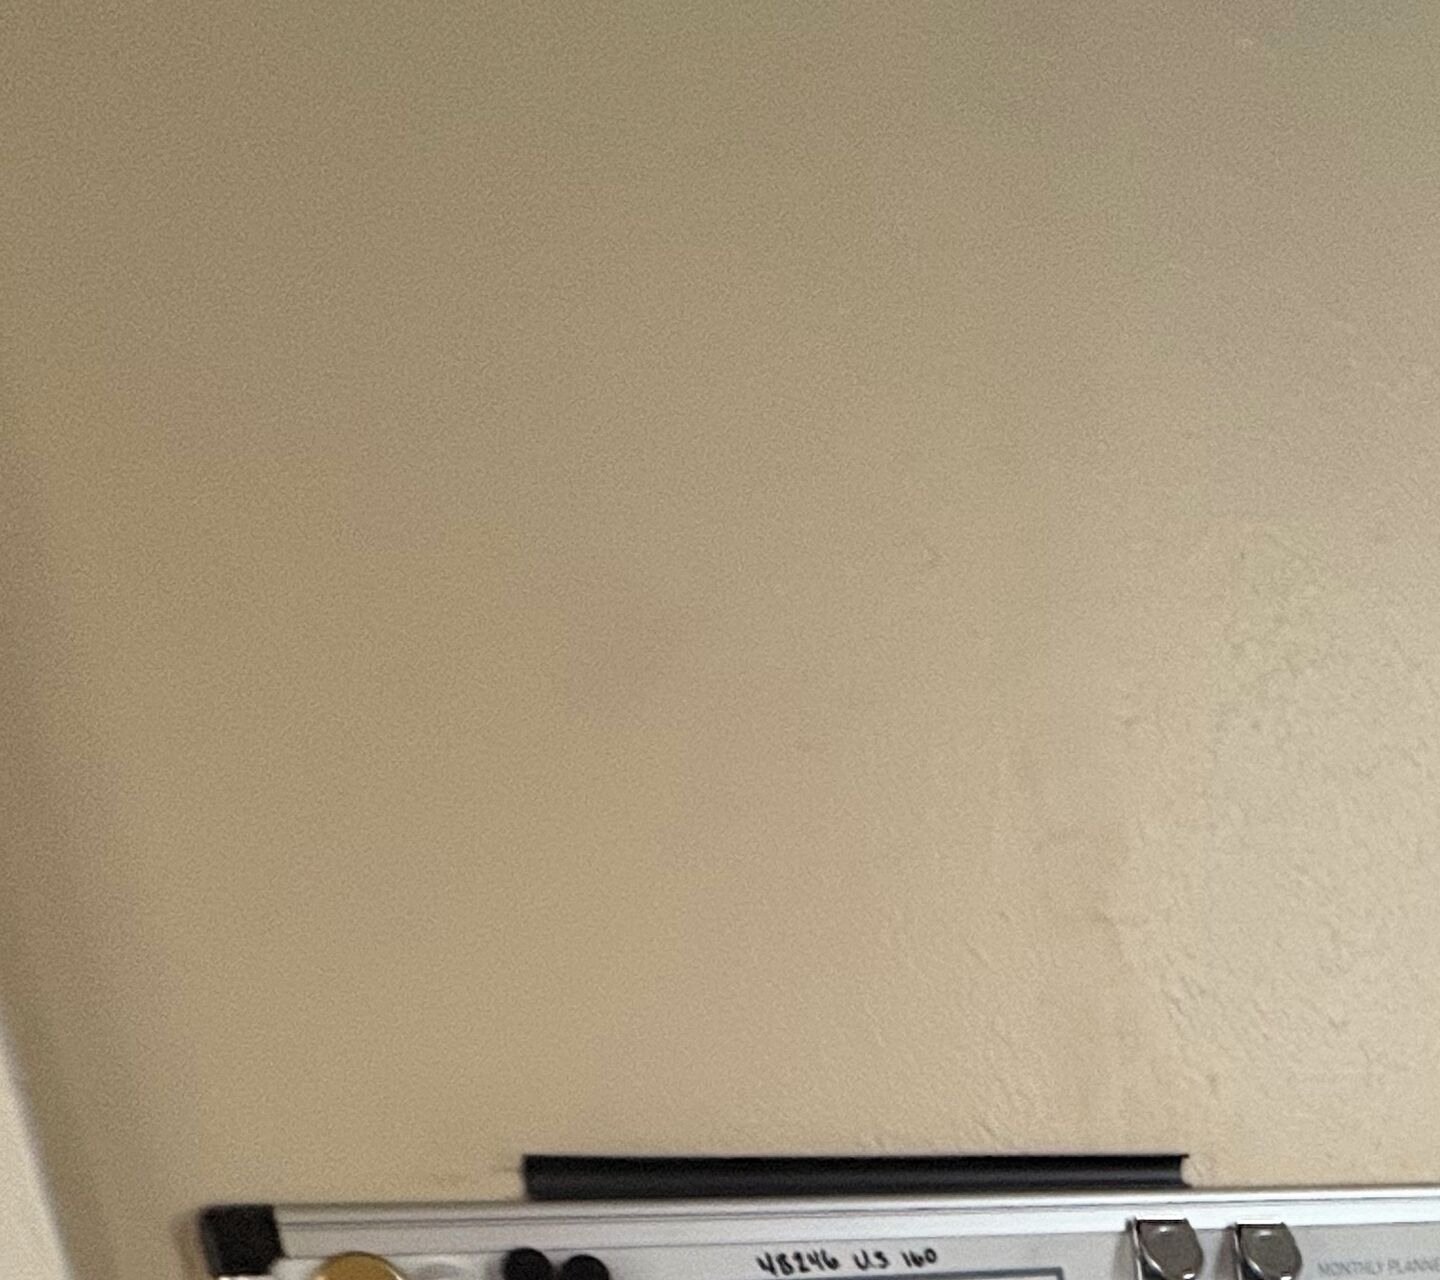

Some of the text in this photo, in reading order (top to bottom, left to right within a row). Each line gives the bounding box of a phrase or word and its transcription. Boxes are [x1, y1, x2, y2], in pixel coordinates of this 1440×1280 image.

[756, 1247, 938, 1277] 48246 US 160
[1317, 1260, 1383, 1277] MONTHLY
